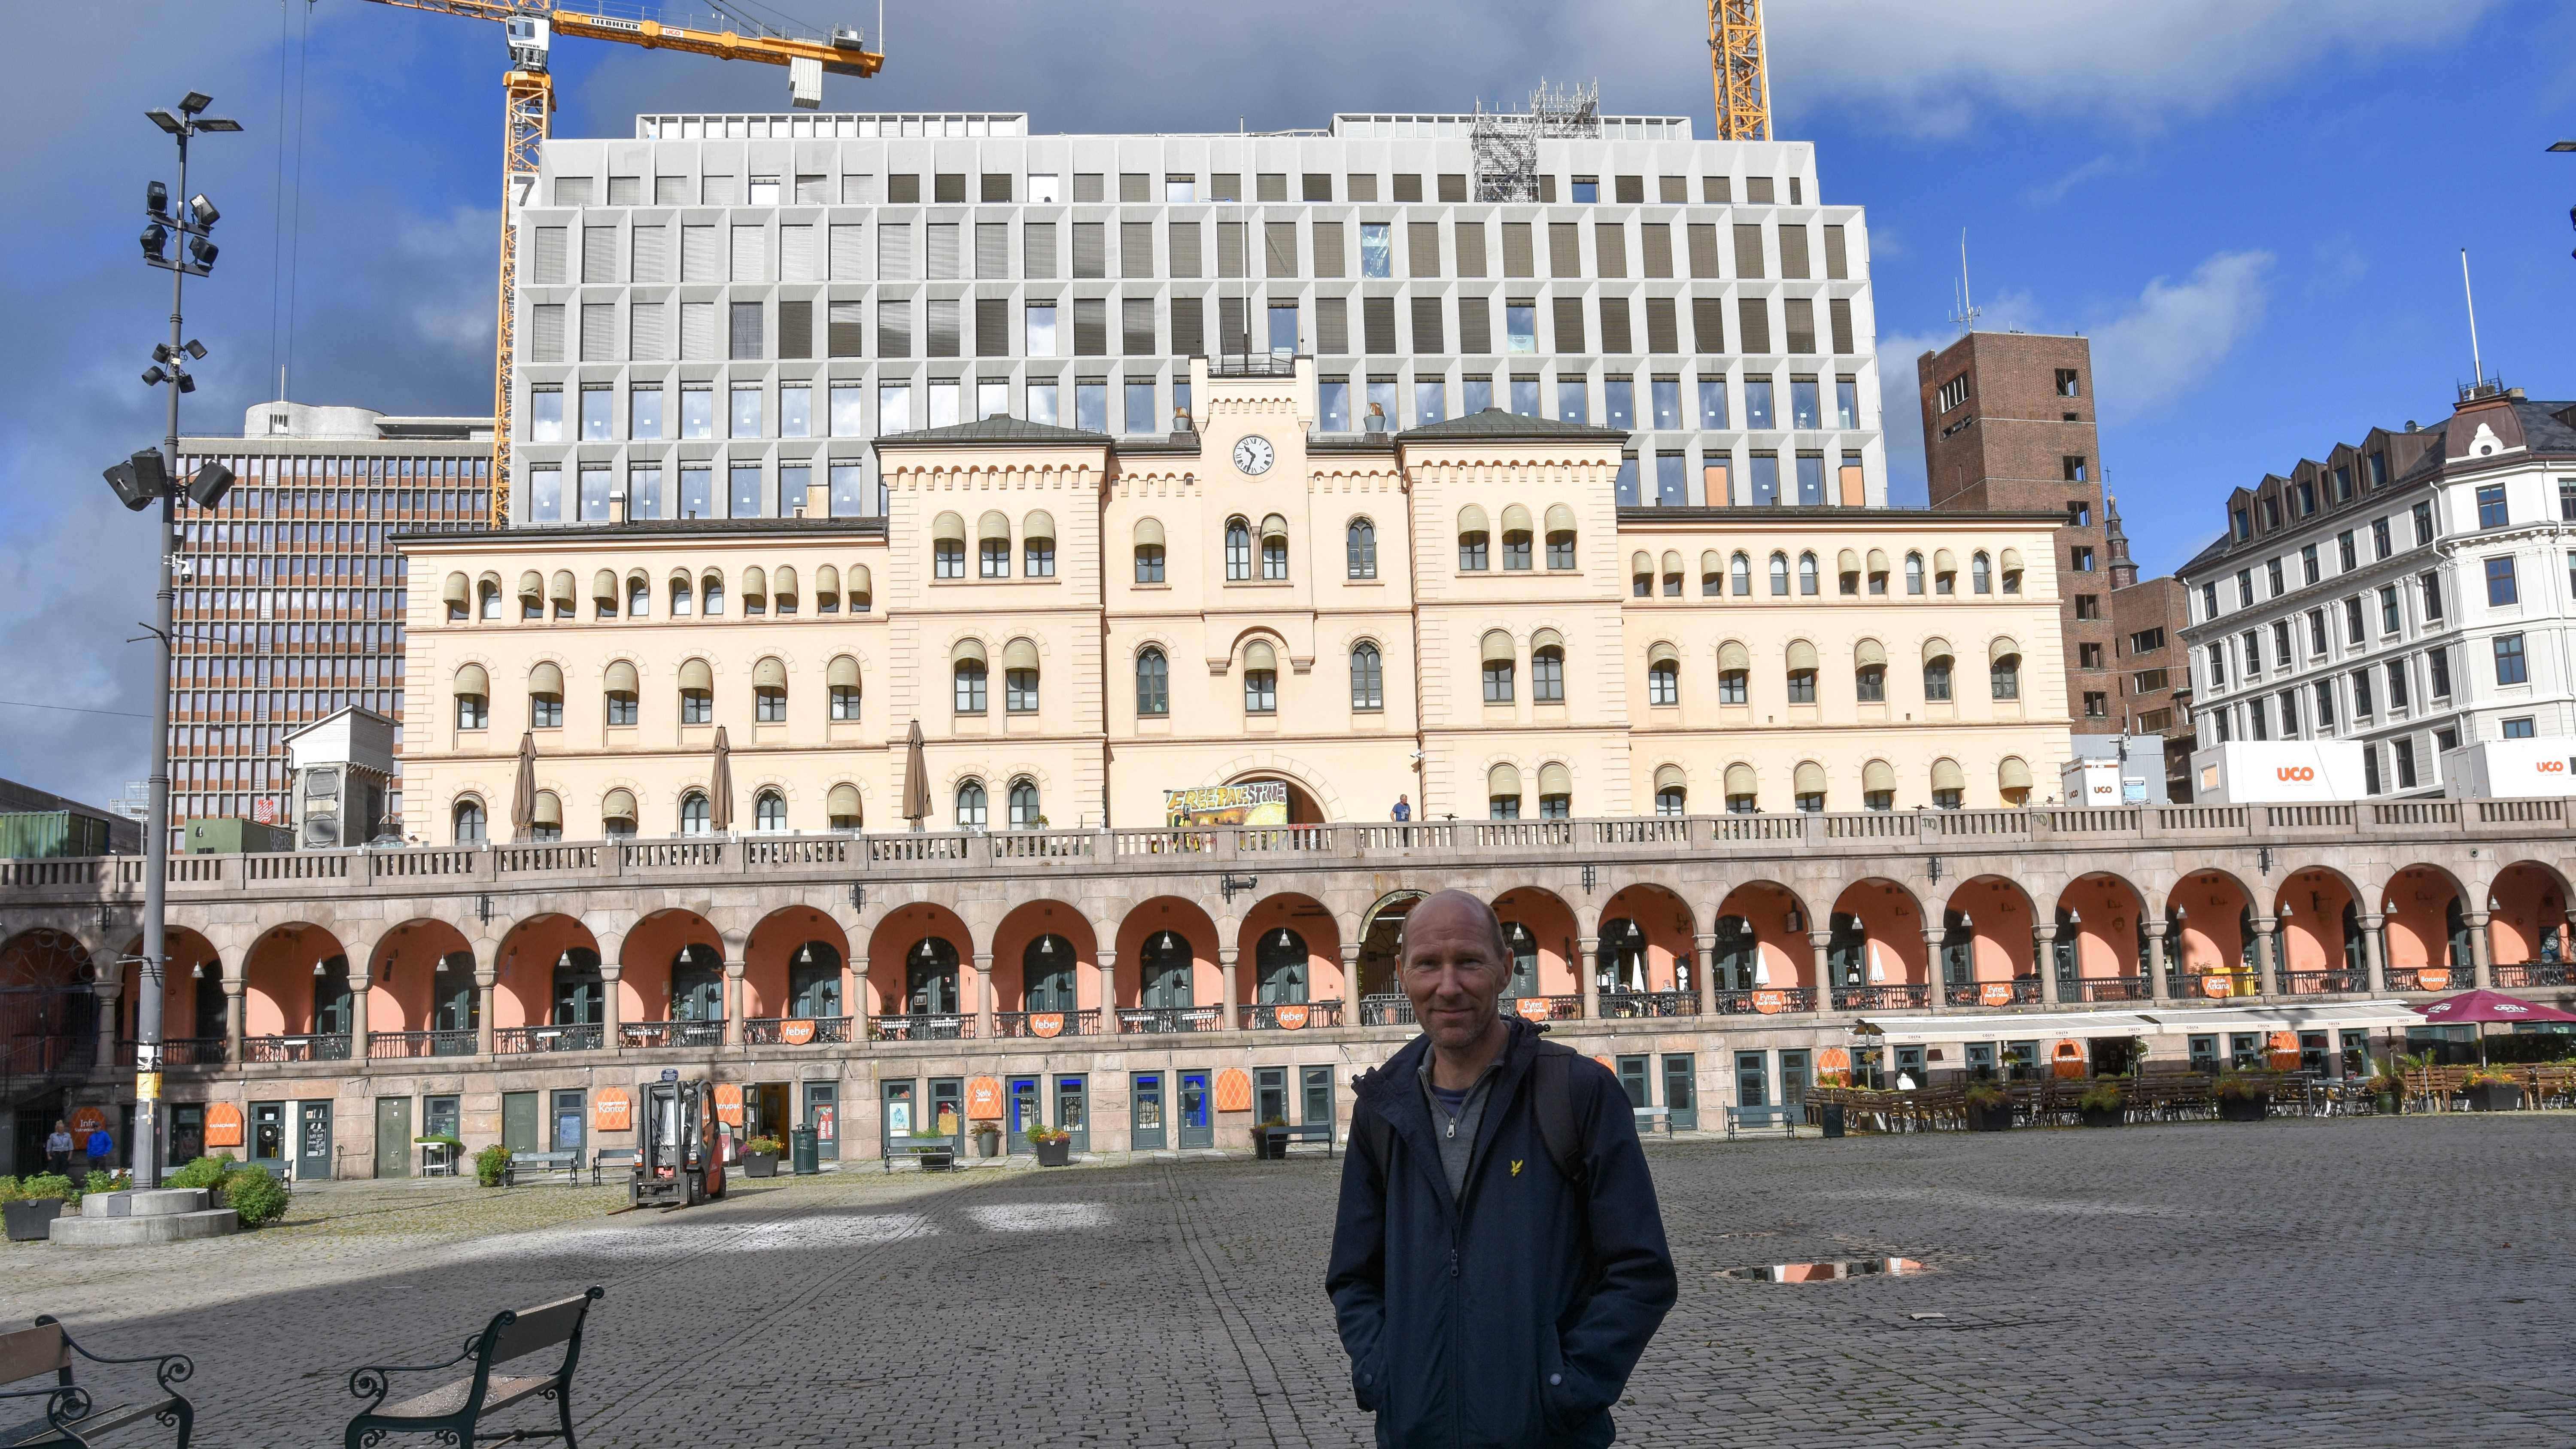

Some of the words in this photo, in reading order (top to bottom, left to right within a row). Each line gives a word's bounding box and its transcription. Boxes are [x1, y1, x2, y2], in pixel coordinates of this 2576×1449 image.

[591, 18, 639, 30] LIEBHERR
[513, 176, 535, 207] 7
[2537, 761, 2564, 772] UCO
[2277, 767, 2314, 781] UCO
[1167, 789, 1217, 811] FREE
[1216, 782, 1286, 807] PALESTINE
[2069, 790, 2078, 799] UCO
[1987, 985, 2005, 994] Fyret
[1760, 993, 1777, 1002] Fyret
[1525, 1001, 1543, 1009] Fyret
[1281, 1012, 1304, 1021] feber
[1036, 1020, 1059, 1029] feber
[786, 1027, 810, 1036] feber
[598, 1105, 626, 1114] Kontor
